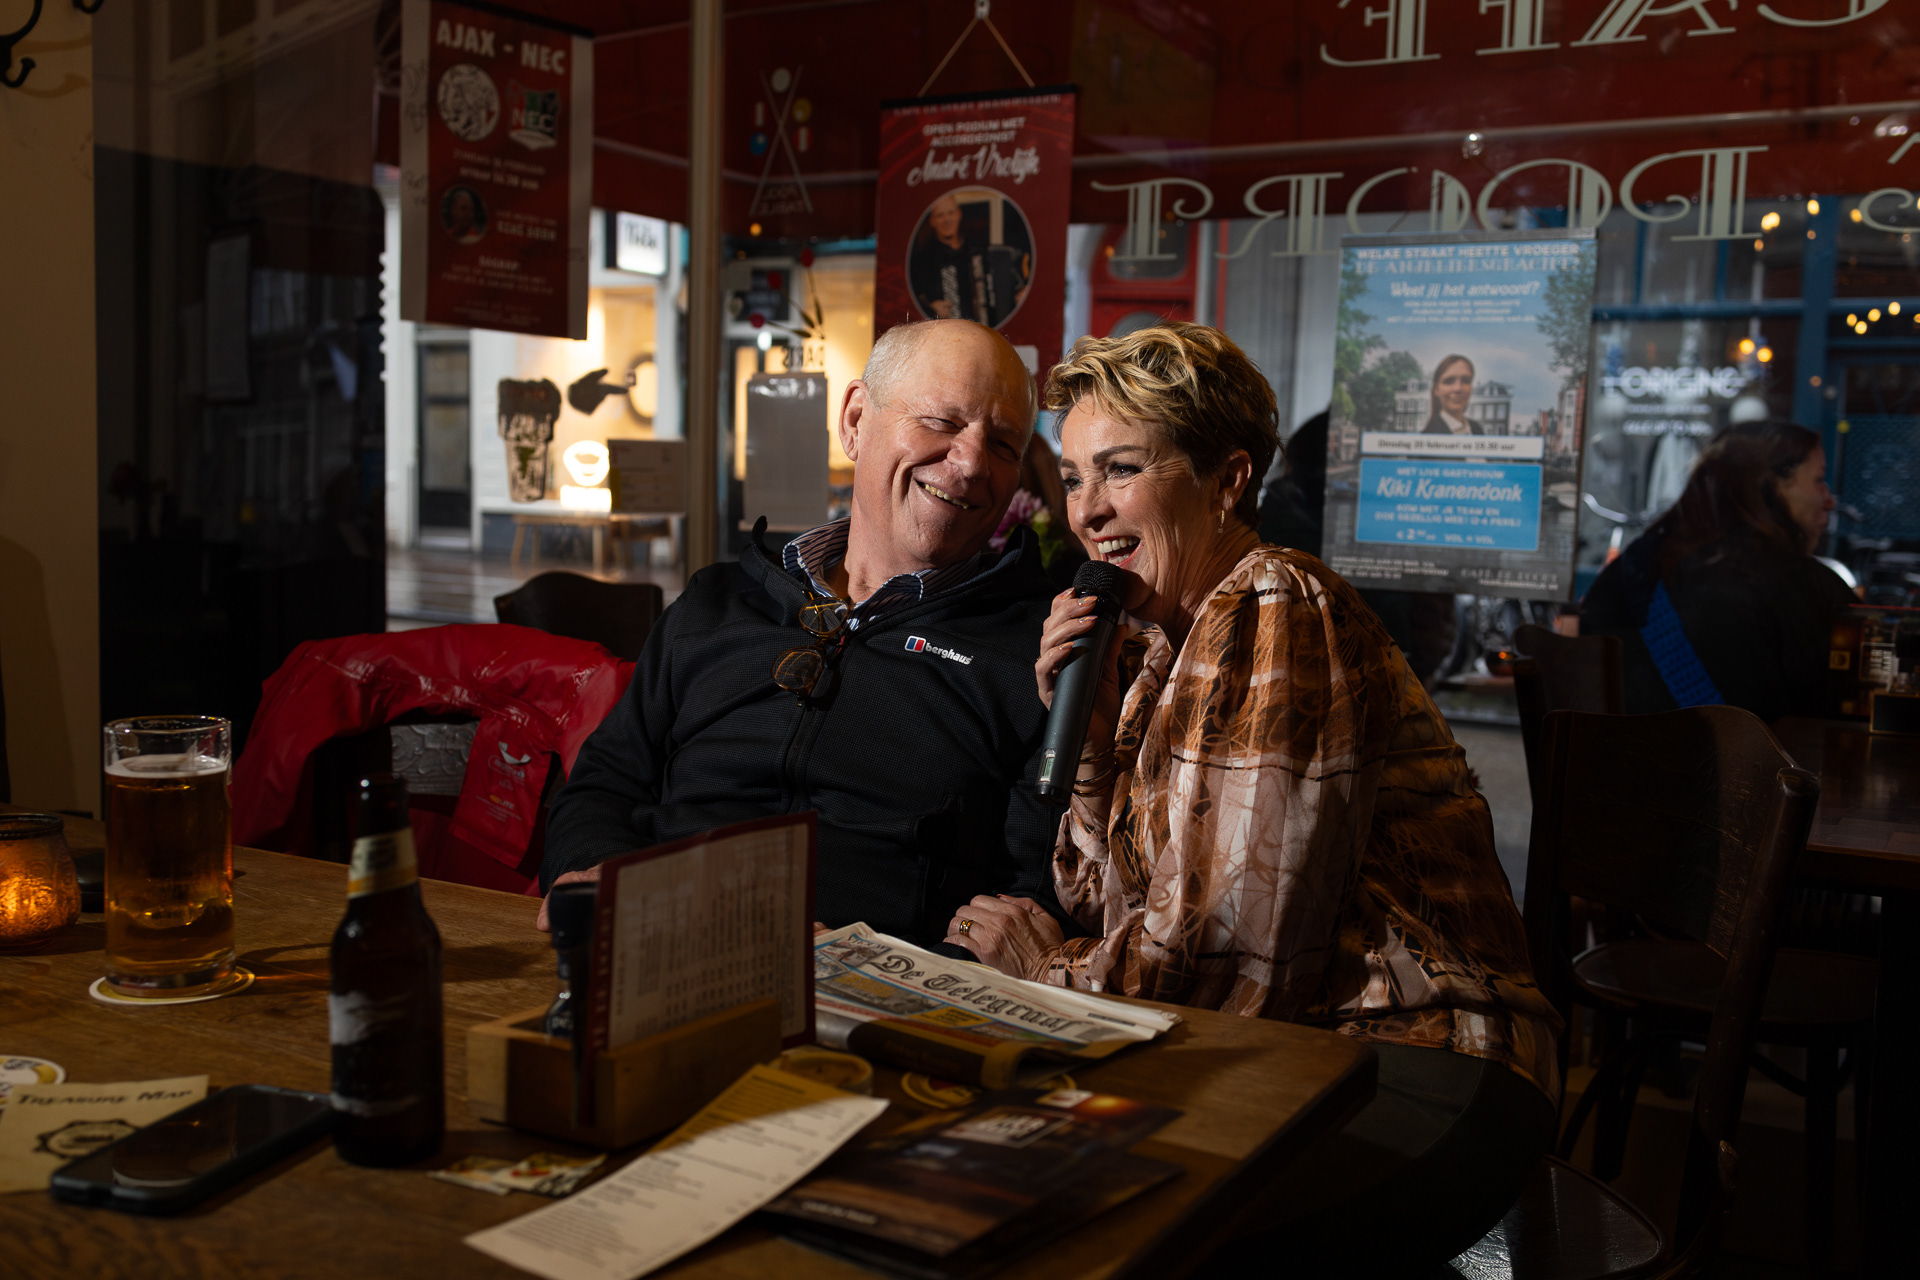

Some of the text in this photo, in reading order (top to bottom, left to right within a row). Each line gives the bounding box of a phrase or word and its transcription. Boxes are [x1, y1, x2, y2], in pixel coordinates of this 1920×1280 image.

[436, 18, 496, 58] AJAX
[521, 40, 566, 76] NEC
[511, 106, 555, 133] NEC
[922, 117, 1026, 137] OPEN PODIUM MET
[1357, 247, 1402, 260] WELKE
[1404, 246, 1456, 259] STRAAT
[1512, 243, 1580, 257] VROEGER
[1390, 280, 1541, 300] Weet jij het antwoord?
[1396, 467, 1416, 476] MET
[1376, 476, 1523, 504] Kiki Kranendonk
[1419, 504, 1440, 513] MET
[1456, 506, 1483, 515] TEAM
[925, 642, 972, 665] berghaus
[869, 953, 926, 980] De
[921, 973, 1096, 1034] Telegraaf
